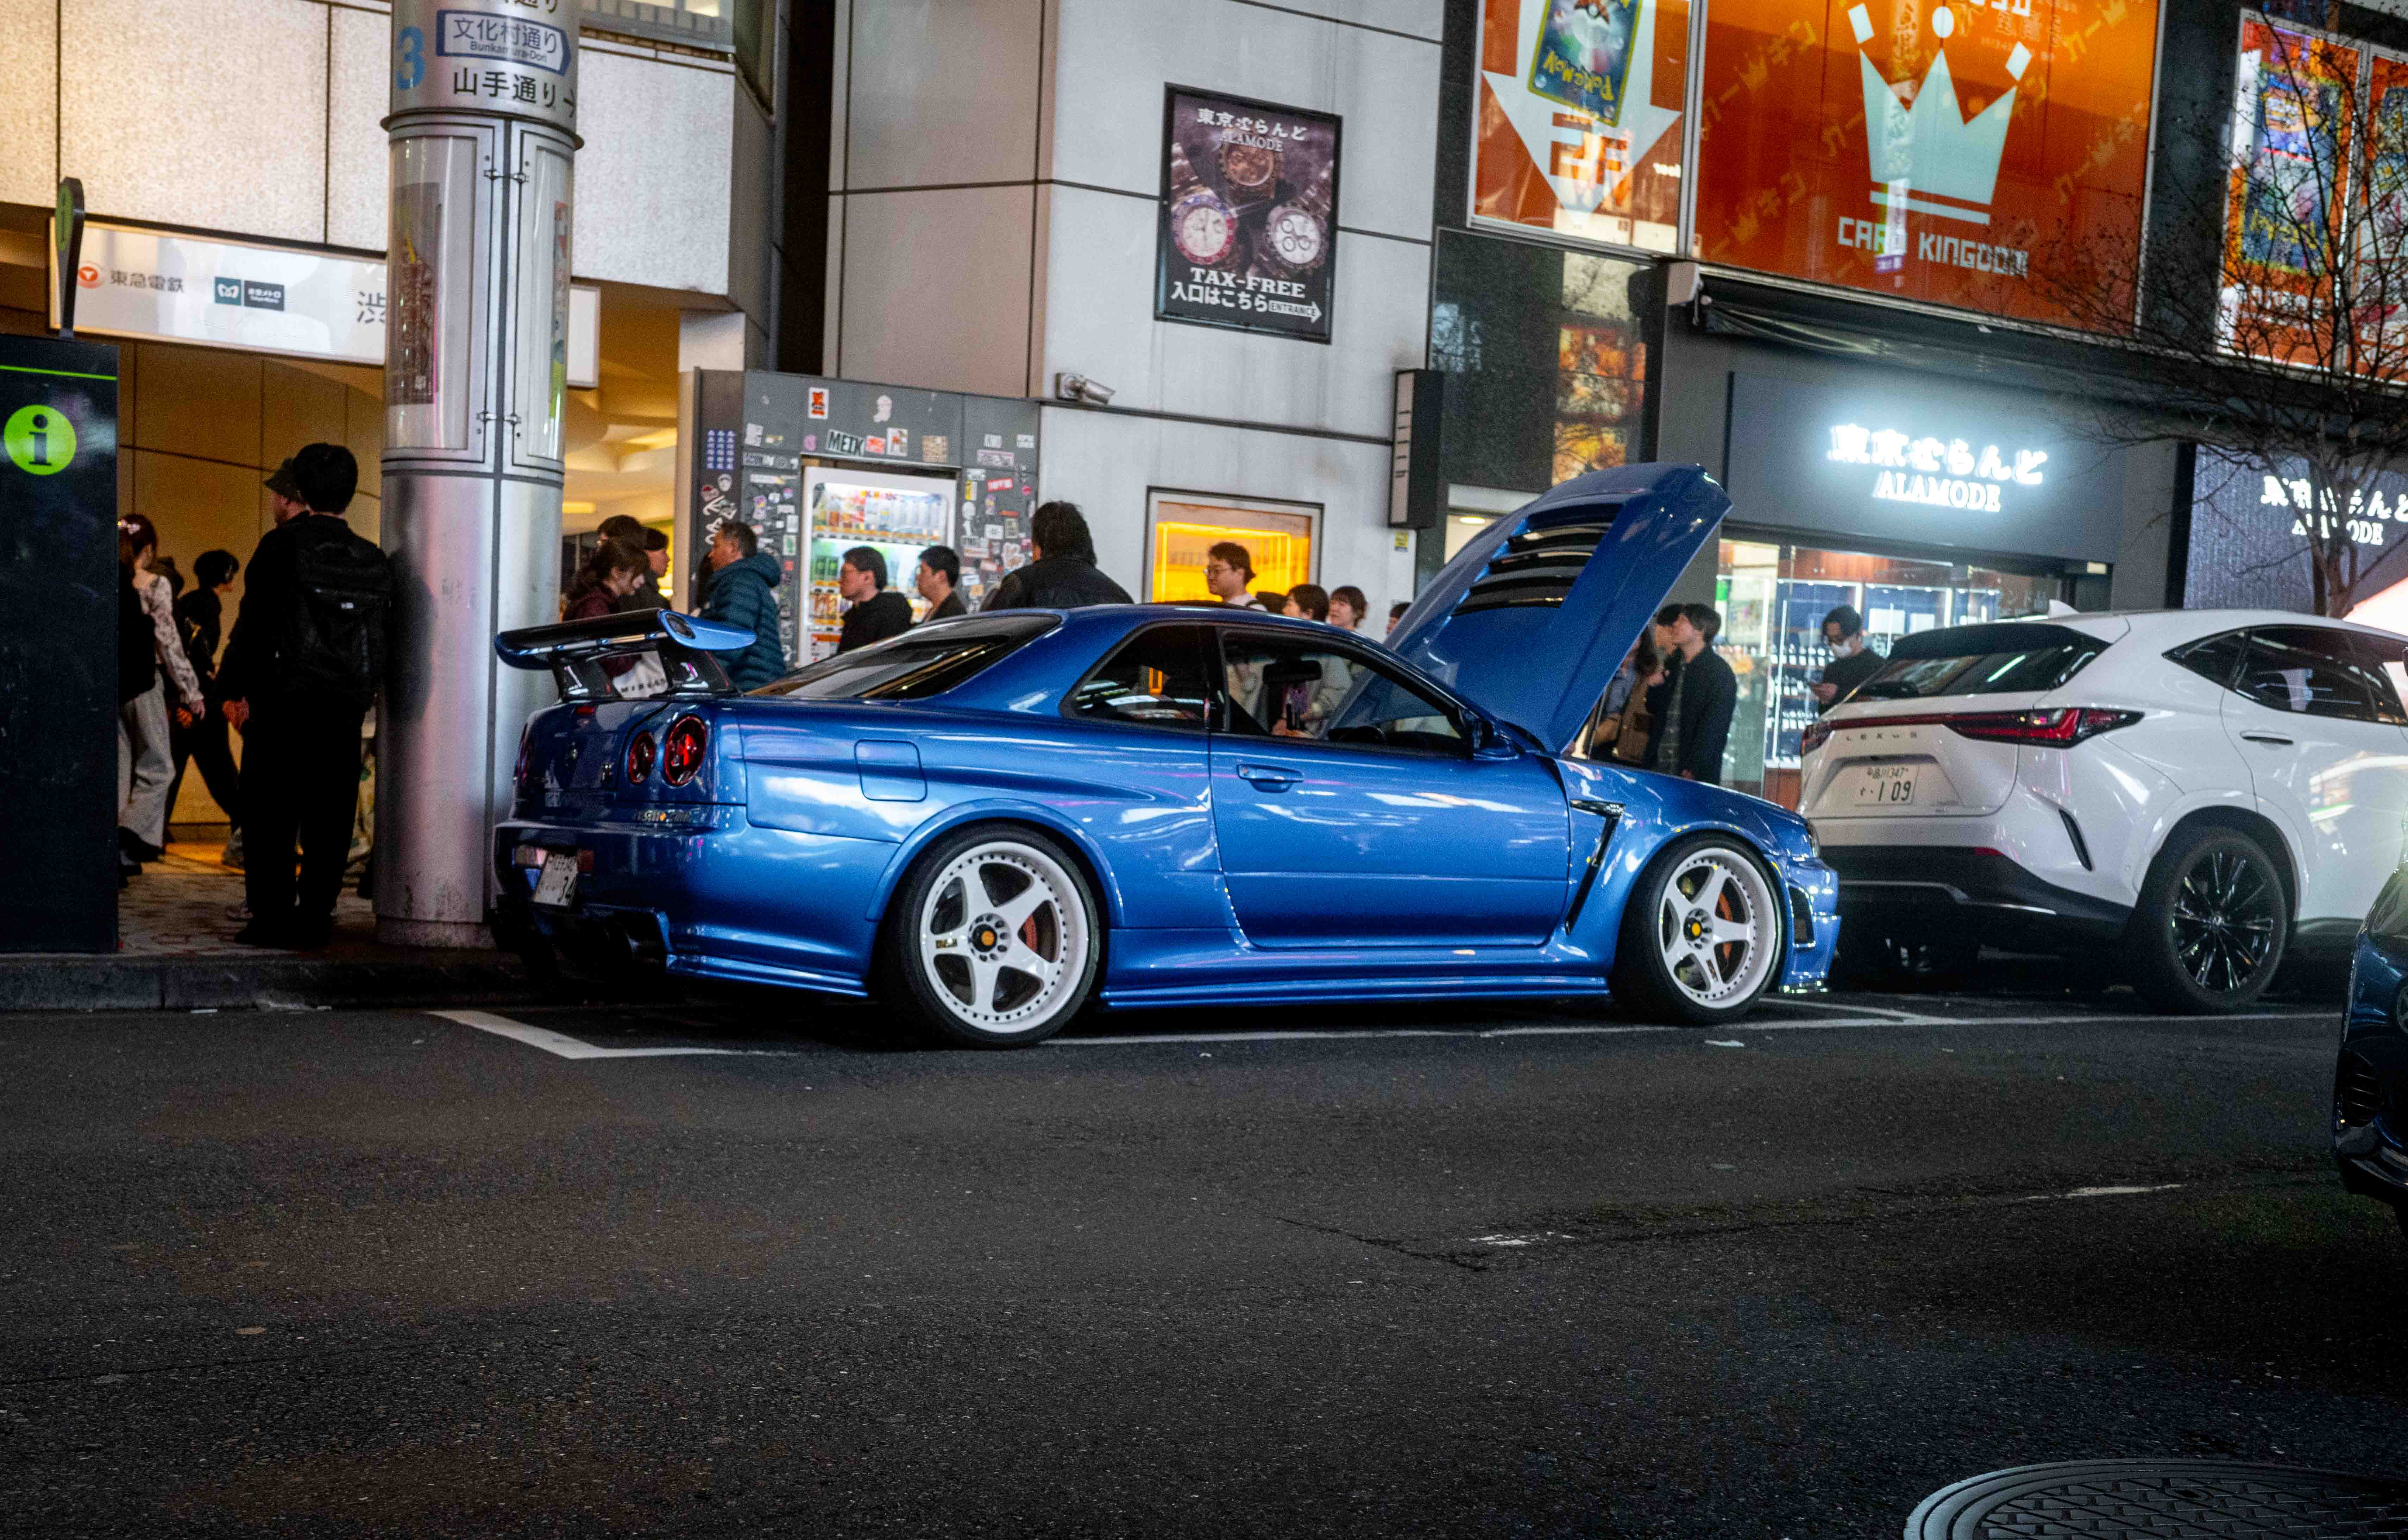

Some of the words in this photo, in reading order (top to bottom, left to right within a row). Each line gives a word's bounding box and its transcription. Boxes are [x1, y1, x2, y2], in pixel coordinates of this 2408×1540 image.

[453, 18, 557, 53] 文化村通り
[397, 25, 426, 91] 3
[453, 67, 556, 108] 山手通り
[1219, 131, 1284, 152] ALAMODE
[1838, 216, 1906, 255] CAR
[1918, 231, 2029, 278] KINGDOM
[110, 270, 184, 293] 東急電鉄
[1171, 281, 1269, 313] 入口はこちら
[1190, 267, 1306, 298] TAX-FREE
[1874, 470, 2001, 513] ALAMODE
